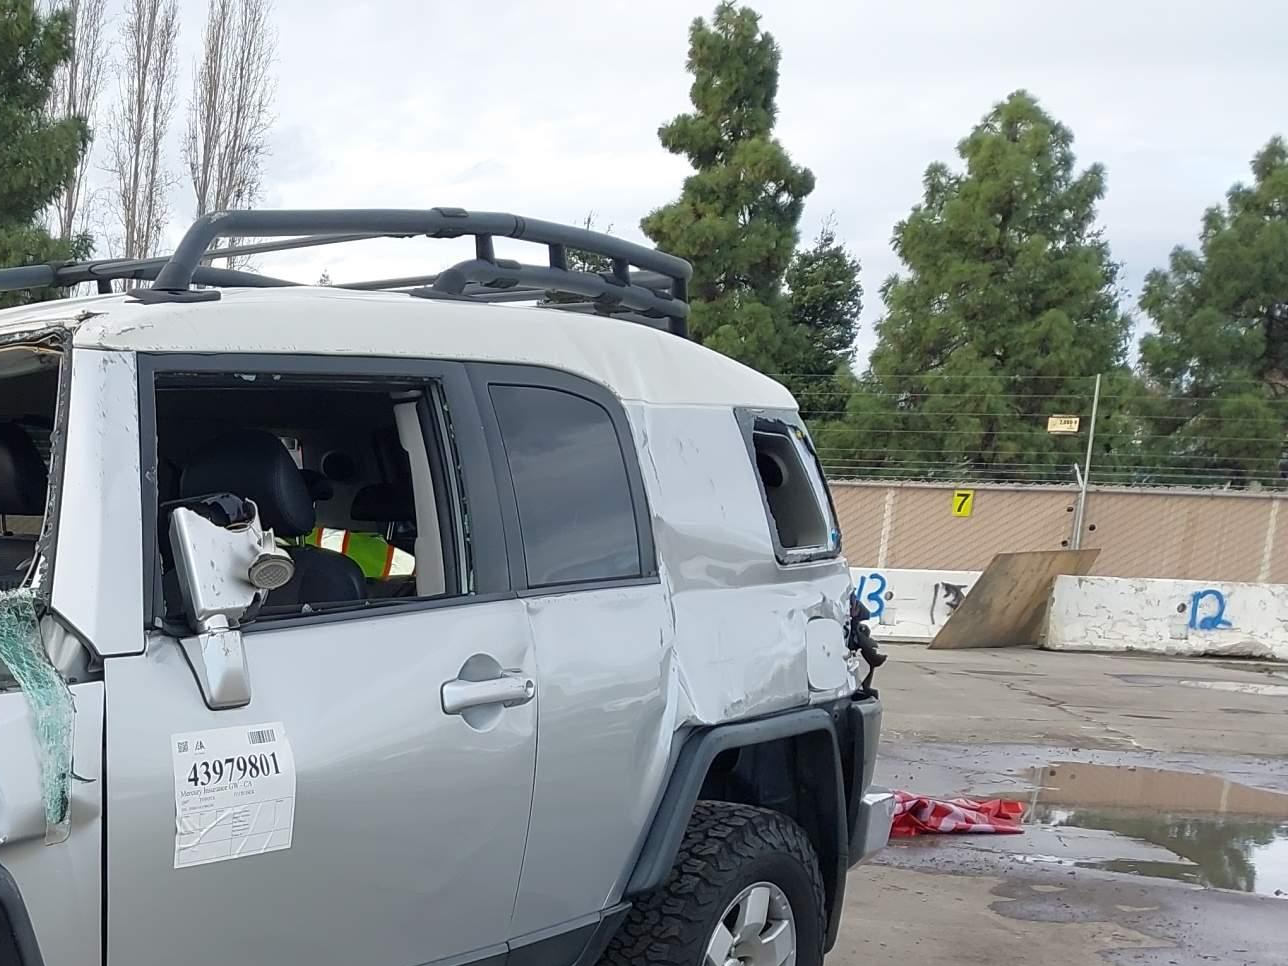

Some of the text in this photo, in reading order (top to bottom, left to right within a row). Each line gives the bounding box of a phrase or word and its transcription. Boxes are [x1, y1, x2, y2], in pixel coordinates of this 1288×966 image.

[956, 493, 972, 513] 7
[855, 573, 887, 618] 13
[1189, 589, 1233, 630] 12
[187, 751, 281, 787] 43979801
